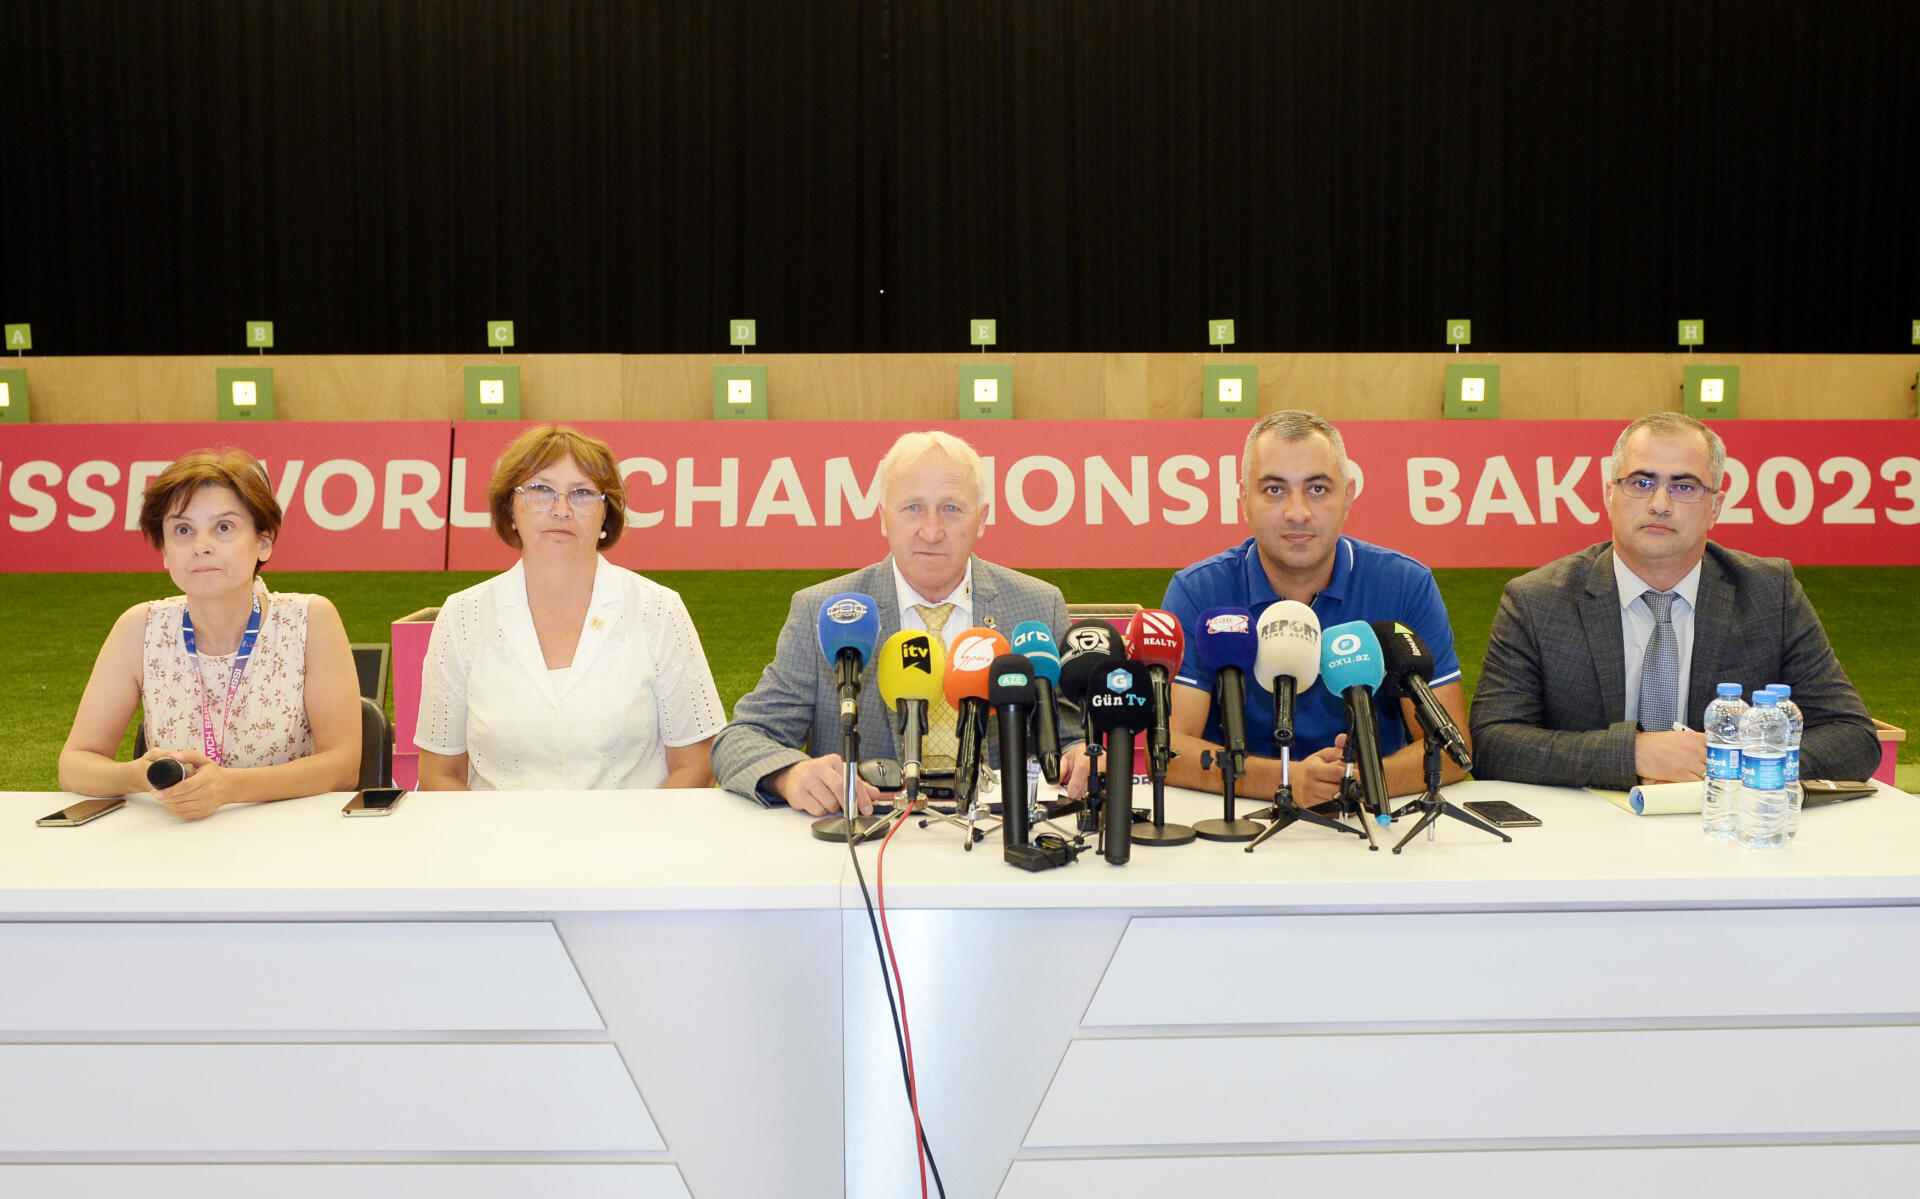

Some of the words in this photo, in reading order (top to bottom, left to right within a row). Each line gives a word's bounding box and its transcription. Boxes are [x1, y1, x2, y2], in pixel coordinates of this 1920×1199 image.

[11, 329, 25, 345] A
[253, 327, 267, 342] B
[494, 326, 508, 342] C
[736, 325, 750, 341] D
[977, 325, 990, 341] E
[1214, 325, 1228, 340] F
[1452, 325, 1466, 341] G
[1684, 325, 1699, 340] H
[0, 460, 174, 531] SSF
[257, 460, 491, 531] ORL
[1407, 457, 1616, 526] BAK
[1719, 456, 1920, 525] 2023
[1014, 630, 1050, 647] arb
[1143, 637, 1167, 647] REAL
[902, 643, 929, 658] itv
[1328, 653, 1371, 669] oxu.az
[1002, 675, 1024, 686] AZE
[1092, 694, 1124, 708] Gün
